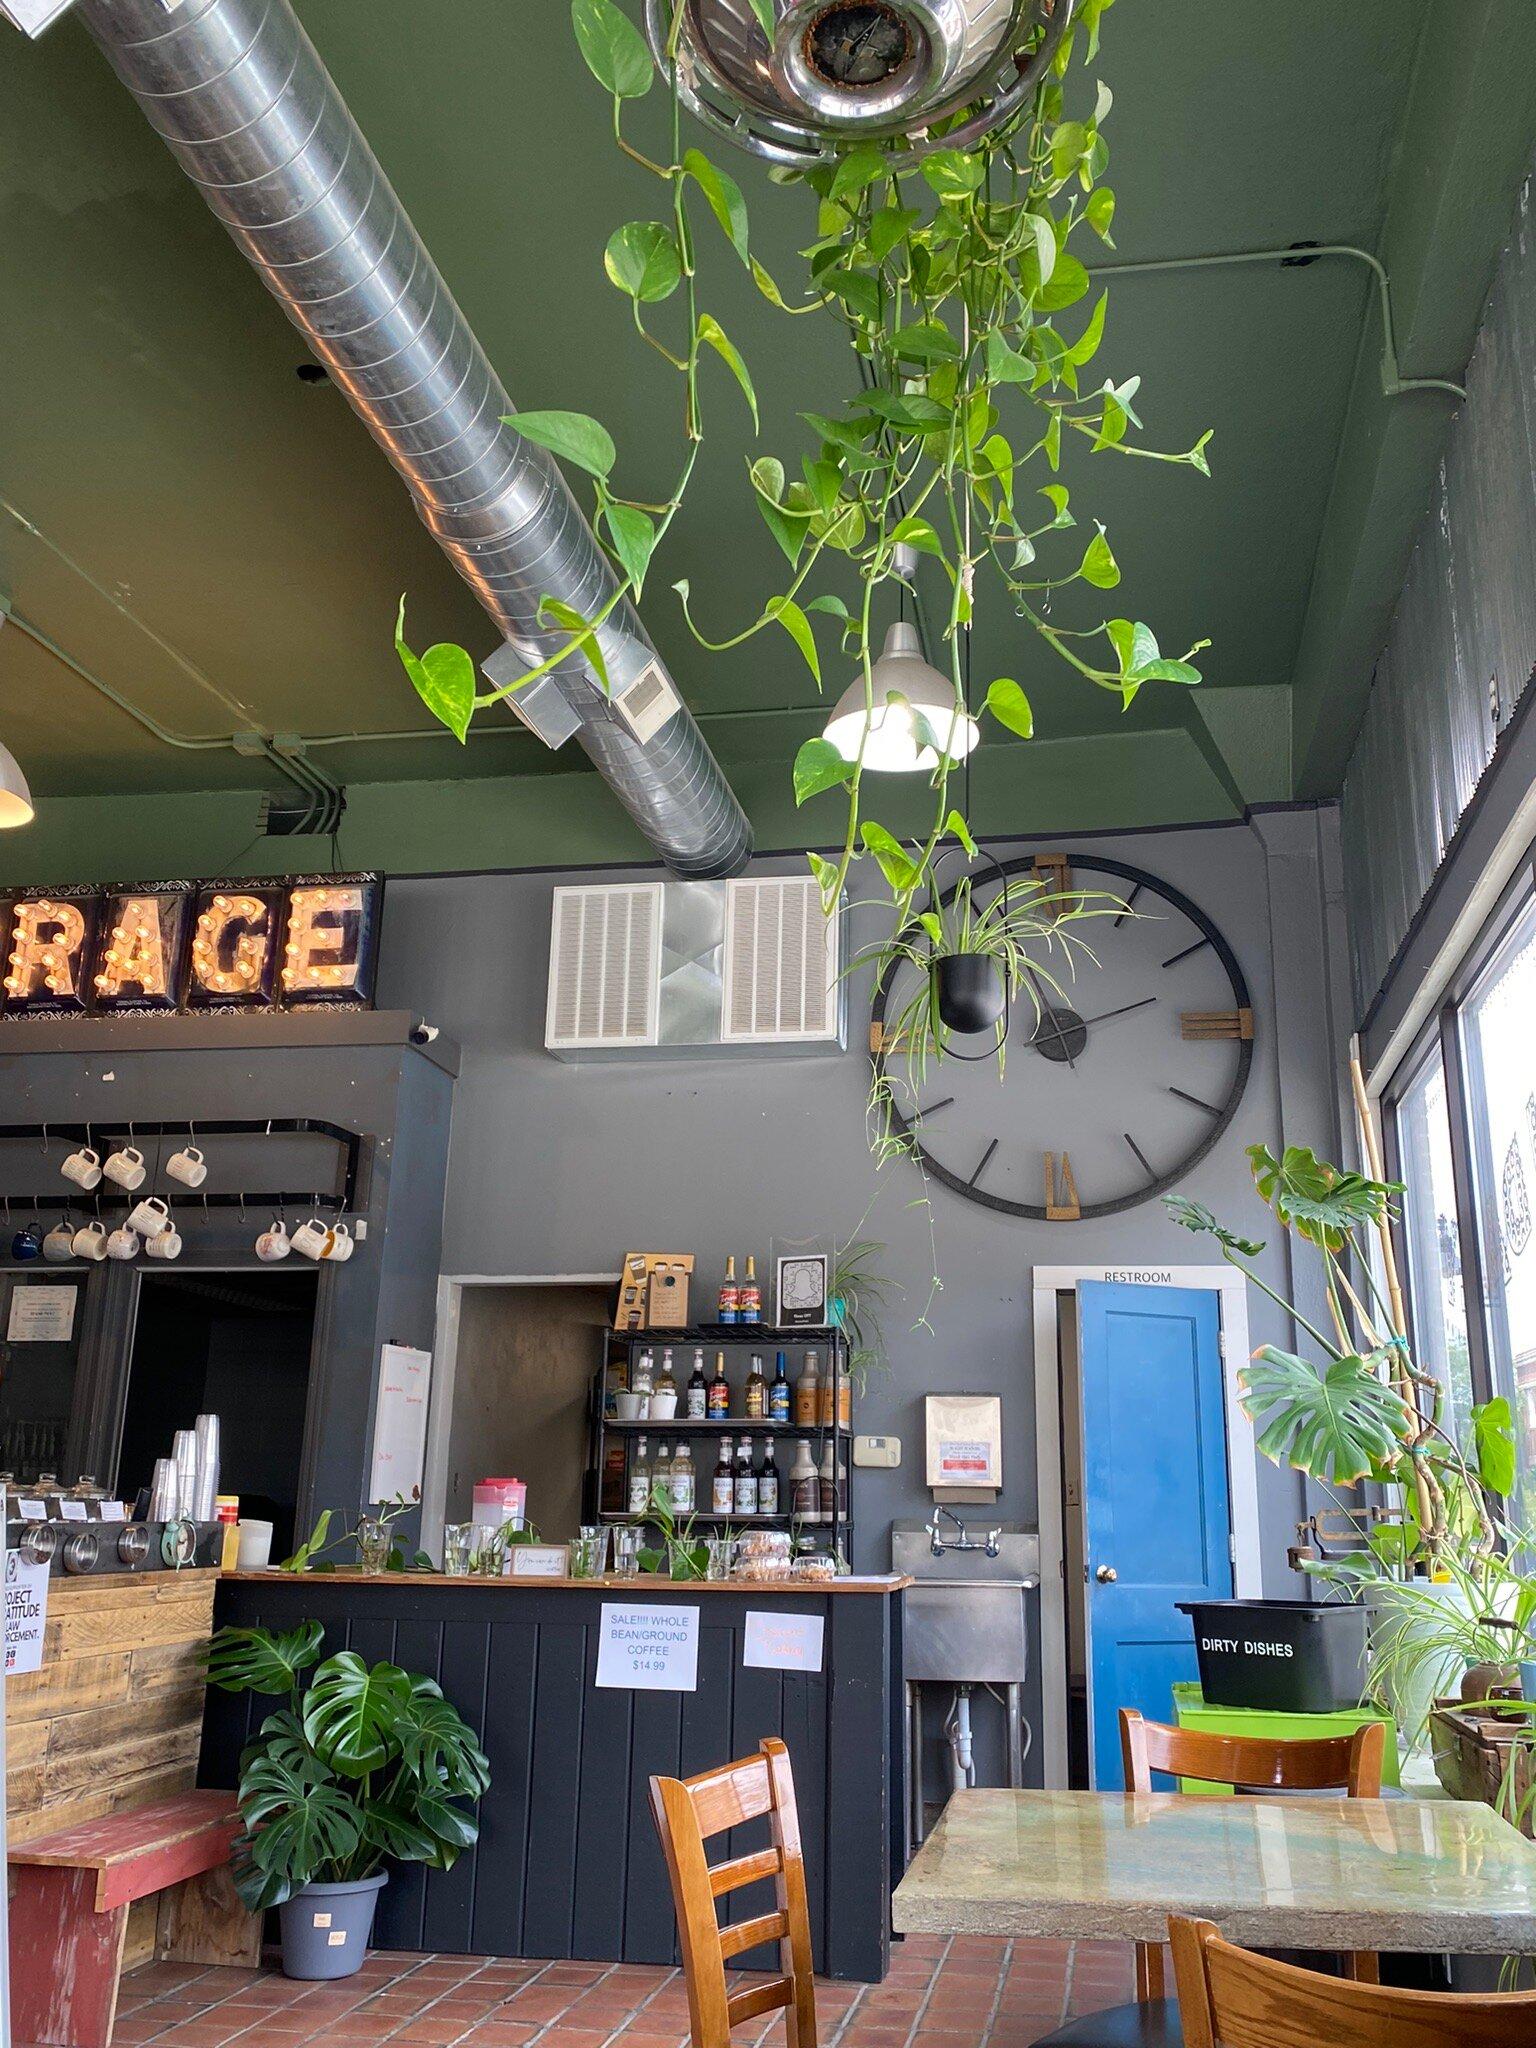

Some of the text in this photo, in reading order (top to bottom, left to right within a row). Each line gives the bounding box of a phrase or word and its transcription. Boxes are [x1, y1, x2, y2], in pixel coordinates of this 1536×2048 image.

[6, 888, 364, 999] RAGE
[1104, 1272, 1171, 1282] RESTROOM
[5, 1590, 32, 1606] OJECT
[651, 1616, 689, 1627] WHOLE
[611, 1629, 688, 1642] BEAN/GROUND
[627, 1644, 669, 1656] COFFEE
[1201, 1638, 1294, 1658] DIRTY DISHES
[632, 1659, 666, 1671] $14.99
